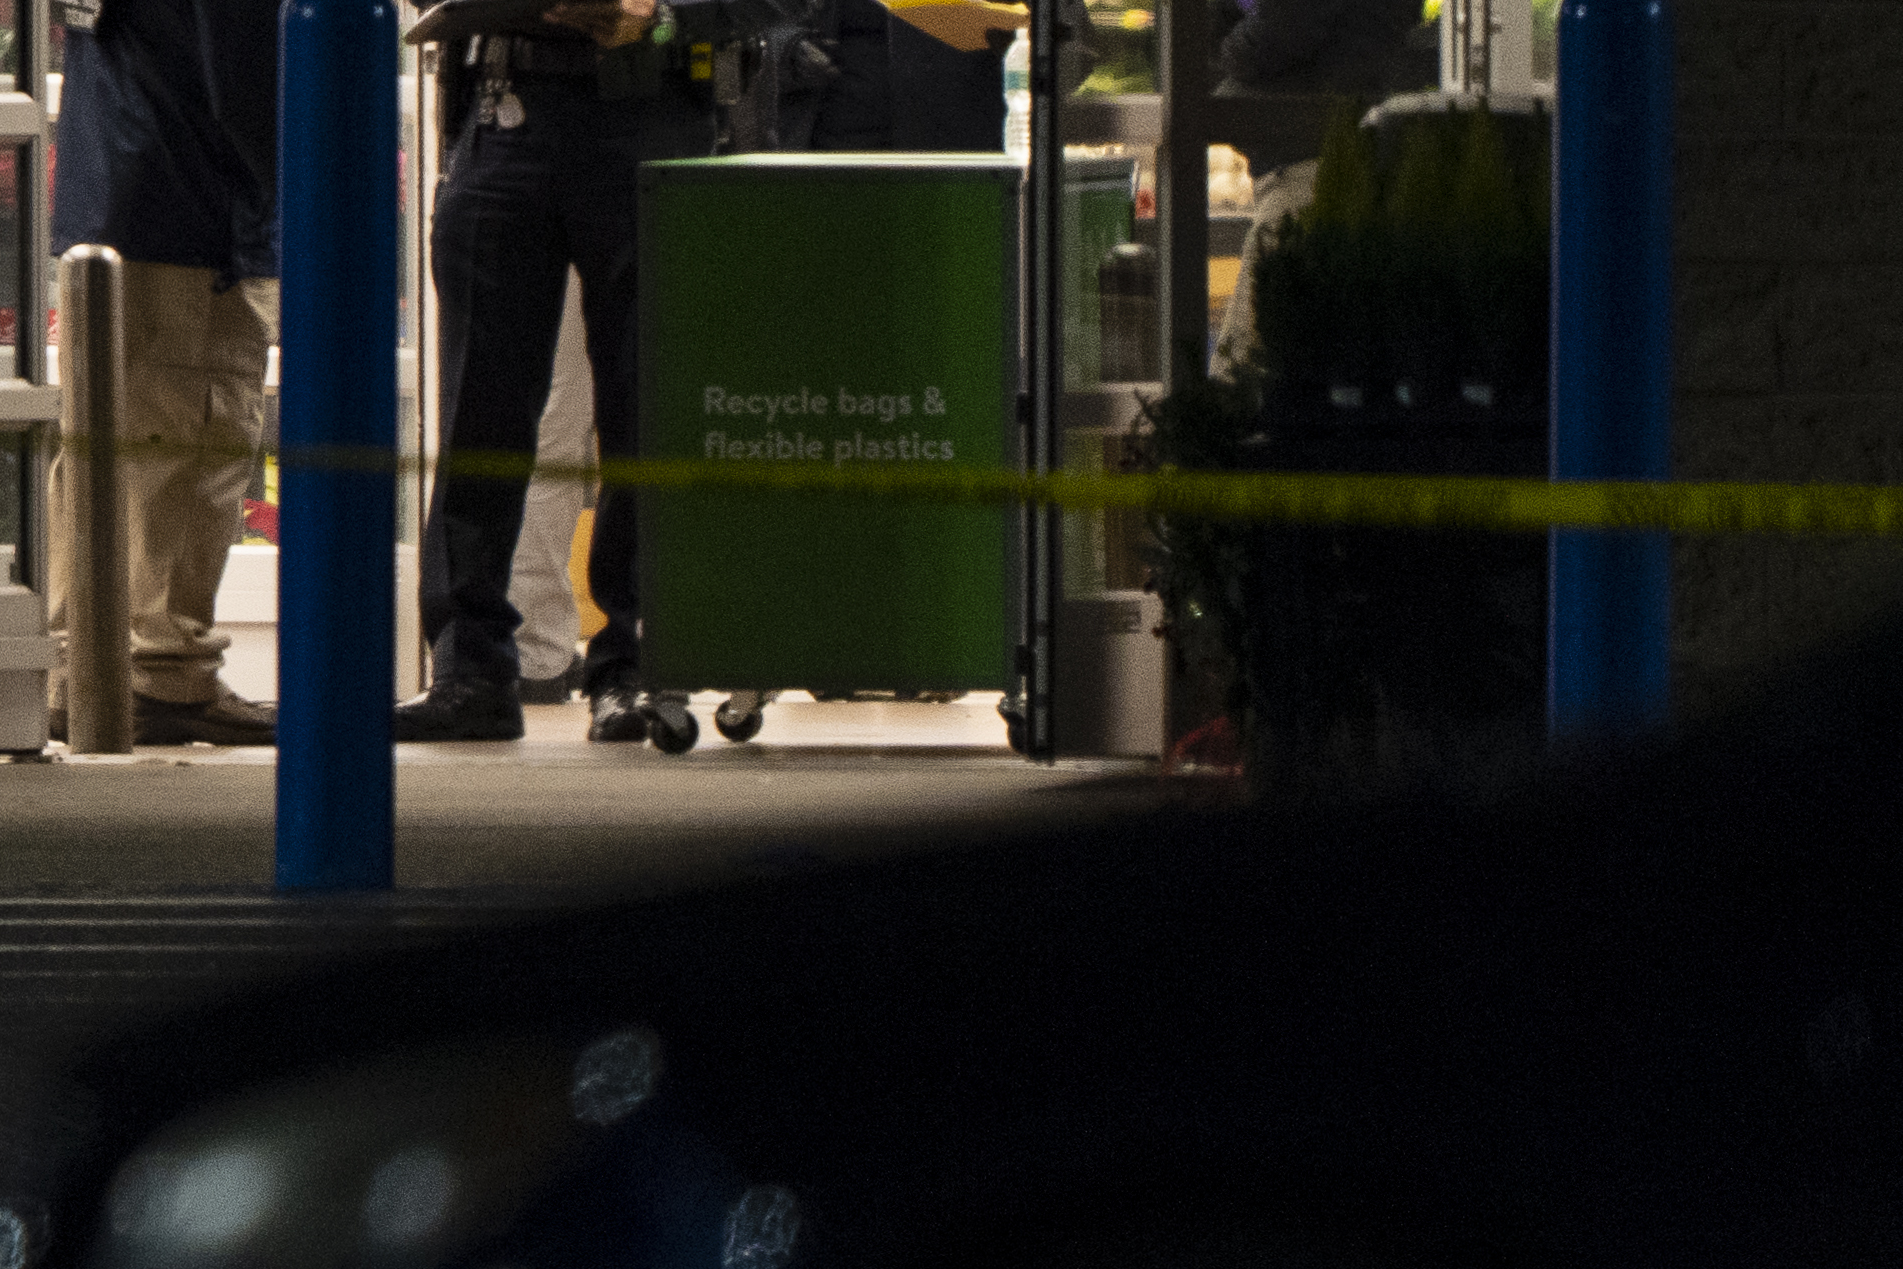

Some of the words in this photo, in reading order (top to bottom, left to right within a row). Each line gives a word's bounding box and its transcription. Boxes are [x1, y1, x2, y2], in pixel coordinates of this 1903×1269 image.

[704, 385, 829, 423] Recycle
[837, 385, 913, 422] bags
[922, 385, 946, 415] &
[704, 430, 825, 460] flexible
[833, 431, 956, 468] plastics
